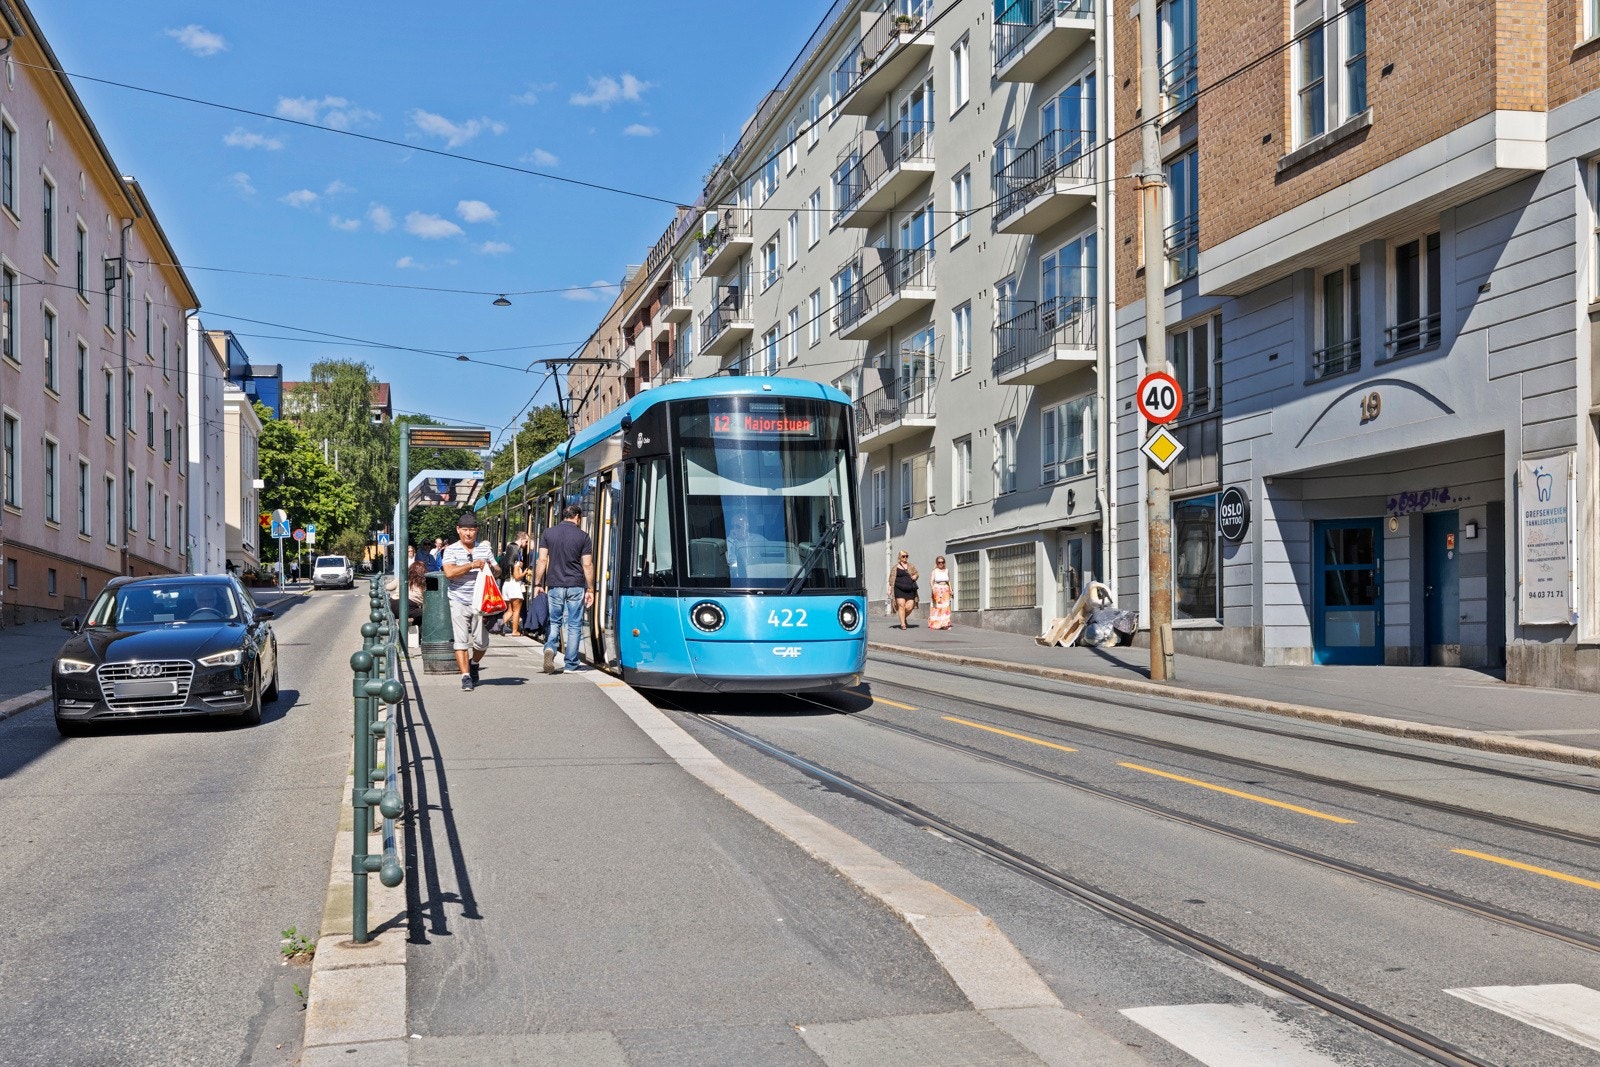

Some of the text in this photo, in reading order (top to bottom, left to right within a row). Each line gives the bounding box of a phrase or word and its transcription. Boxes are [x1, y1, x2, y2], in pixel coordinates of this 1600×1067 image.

[1145, 385, 1175, 410] 40
[1361, 391, 1382, 421] 19
[714, 415, 811, 434] 12 Majorstuen
[1222, 502, 1242, 518] OSLO
[1222, 516, 1242, 526] TATTOO
[767, 608, 808, 628] 422
[772, 646, 802, 658] CAF
